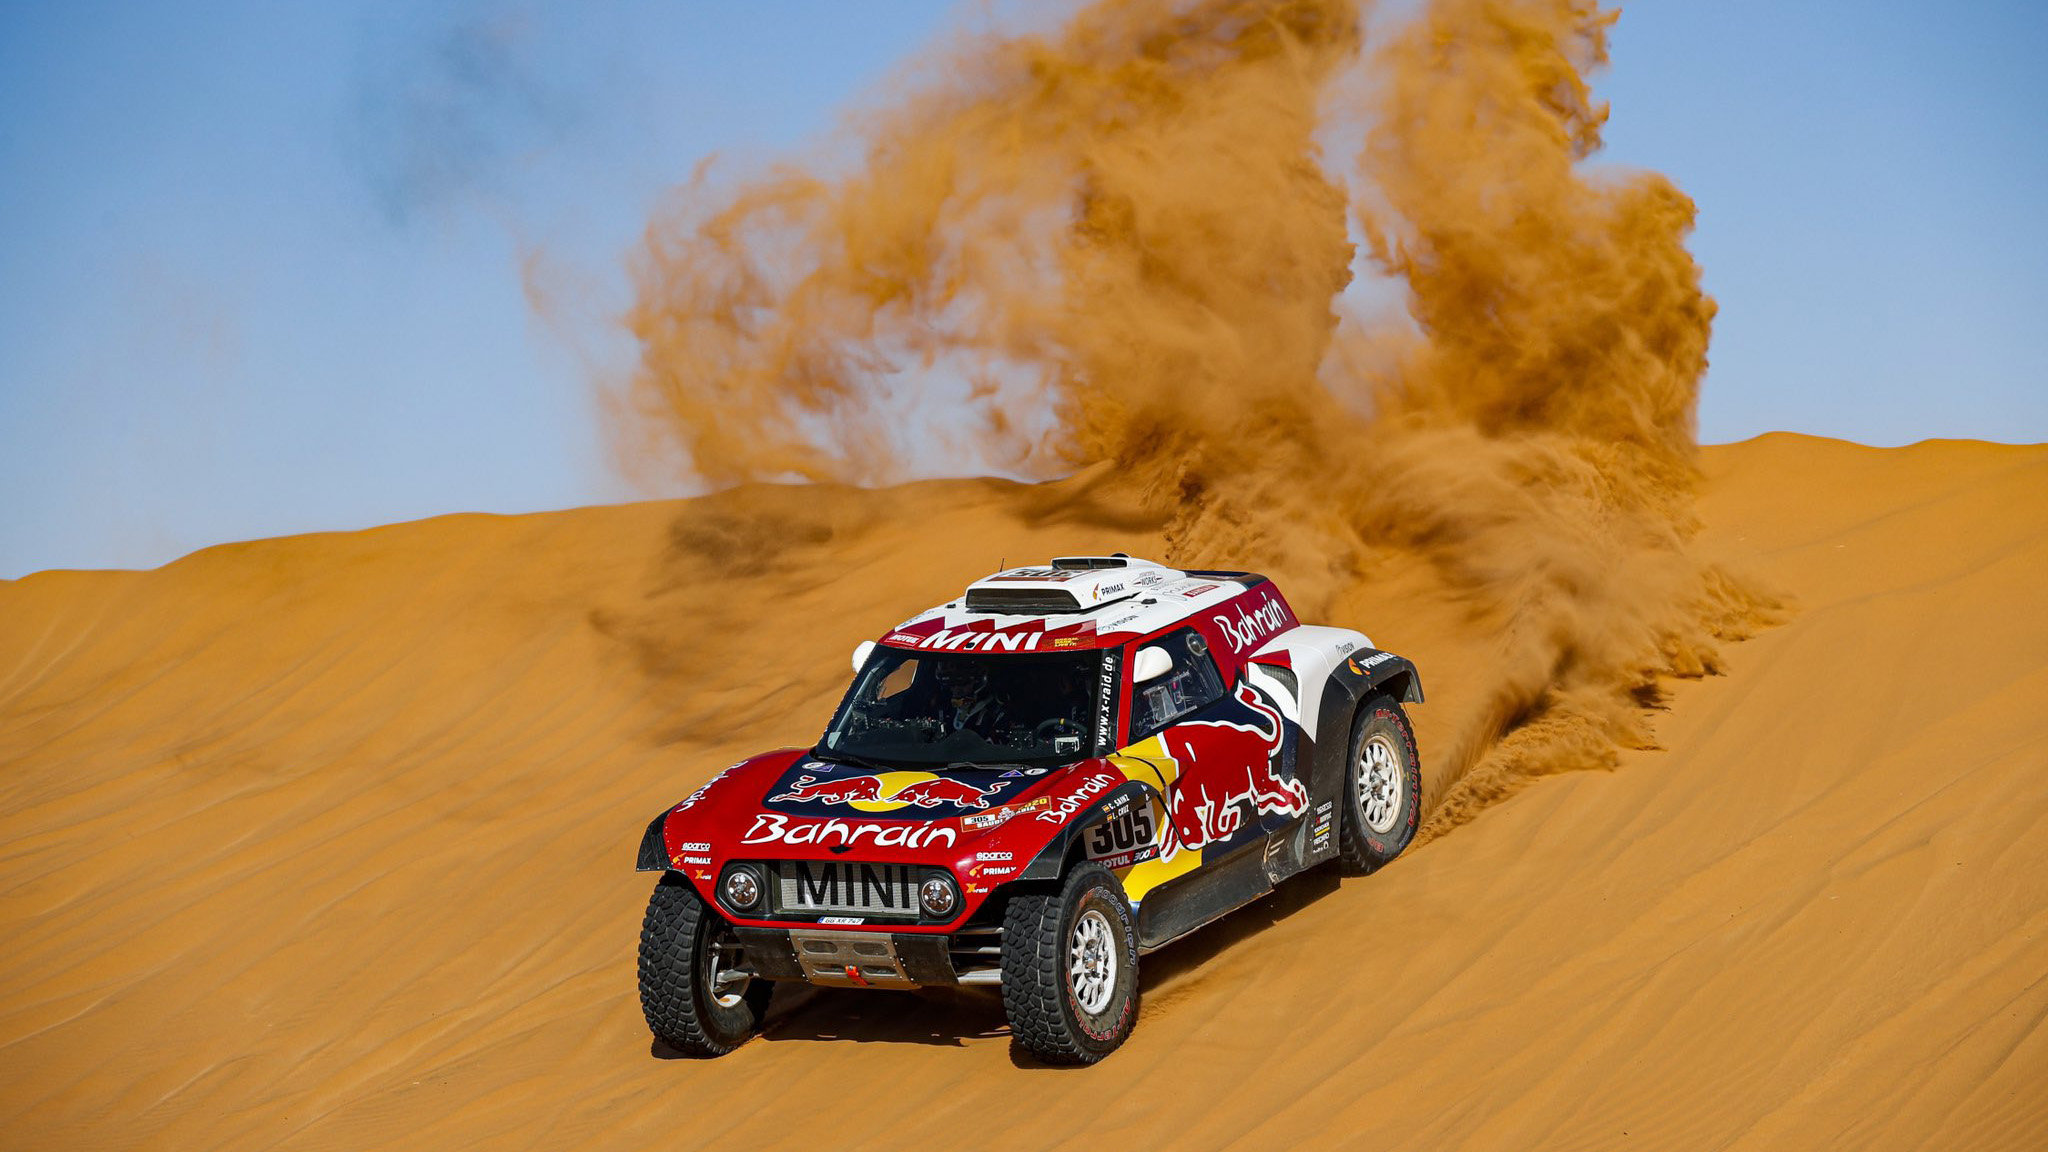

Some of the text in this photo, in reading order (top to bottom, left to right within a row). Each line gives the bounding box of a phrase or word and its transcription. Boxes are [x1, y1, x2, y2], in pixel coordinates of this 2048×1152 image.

[1101, 582, 1125, 596] PRIMAX
[1213, 591, 1288, 654] Bahrain
[918, 629, 1044, 651] MINI
[1097, 656, 1114, 746] www.x-raid.de
[1035, 774, 1116, 825] Bahrain
[1114, 794, 1130, 807] SAINZ
[1118, 804, 1130, 816] CRUZ
[740, 813, 957, 849] Bahrain
[1092, 803, 1153, 855] 305
[684, 856, 712, 865] PRIMAX
[976, 851, 1013, 861] sparco
[796, 862, 910, 909] MINI
